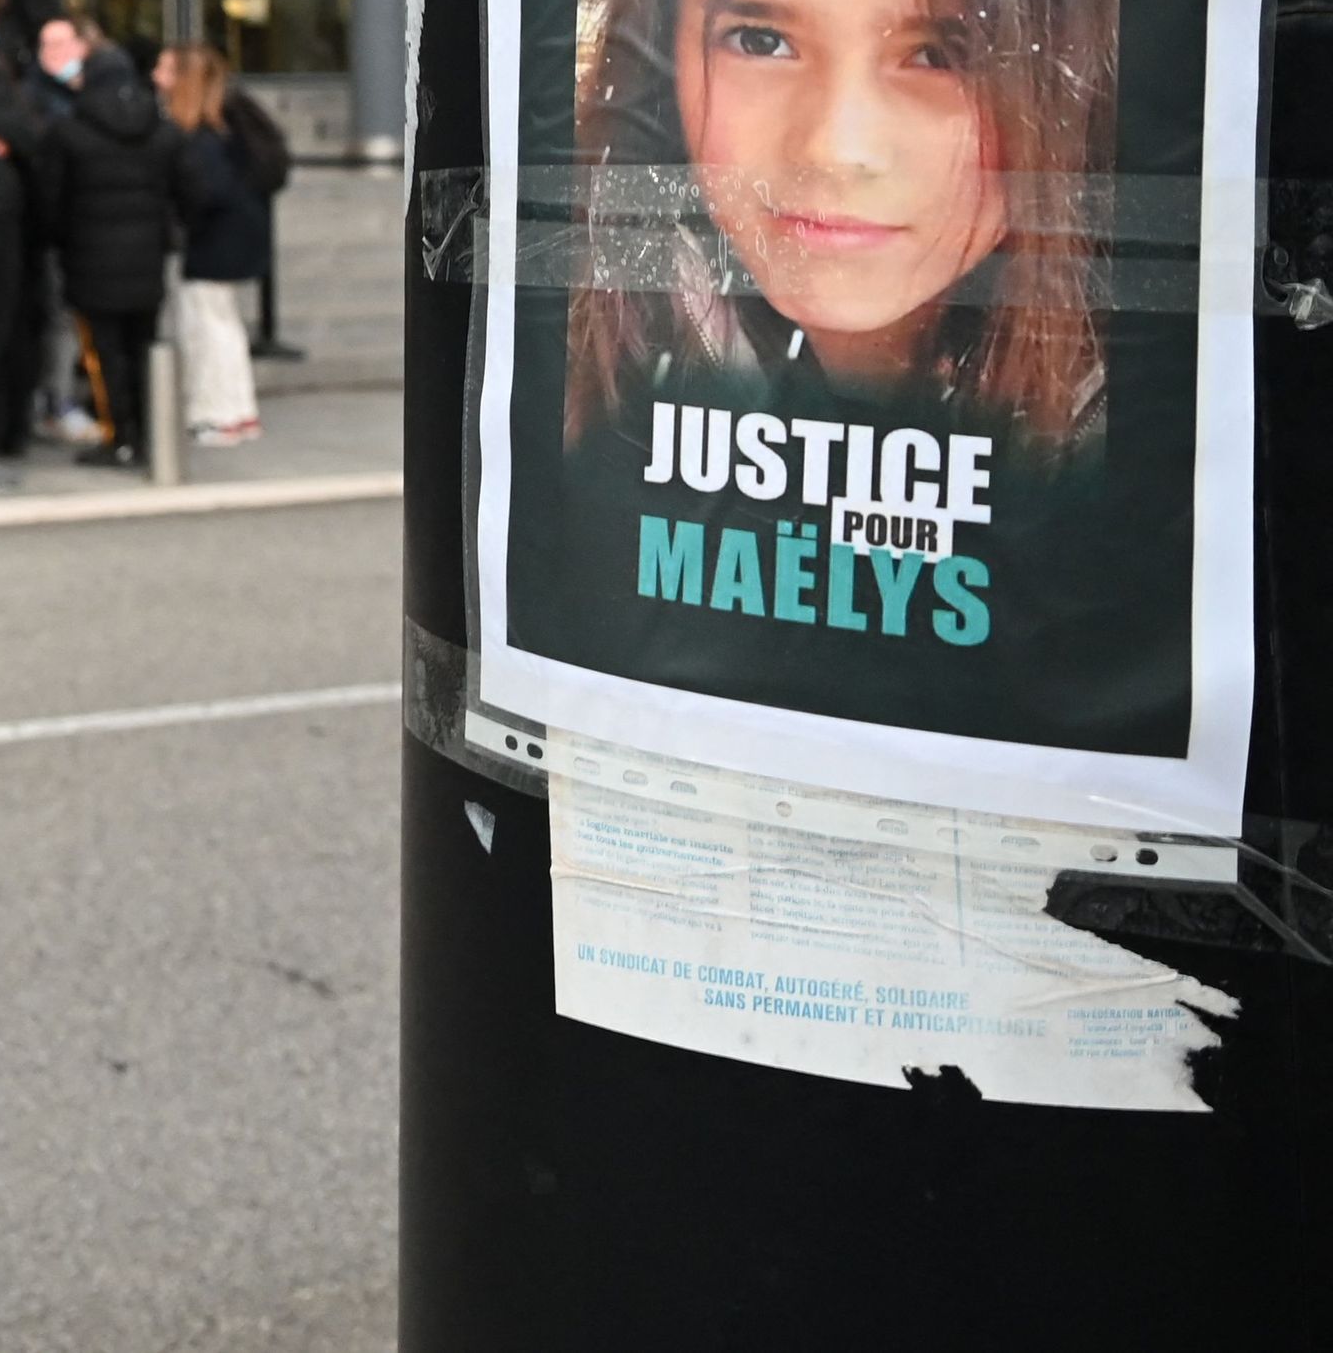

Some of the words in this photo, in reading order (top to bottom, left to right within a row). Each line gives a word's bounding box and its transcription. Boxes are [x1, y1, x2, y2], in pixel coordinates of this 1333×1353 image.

[643, 401, 993, 524] JUSTICE
[842, 509, 938, 552] POUR
[637, 514, 991, 647] MAËLYS
[577, 943, 595, 962] UN
[599, 947, 669, 976] SYNDICAT
[673, 960, 693, 980] DE
[697, 965, 769, 993] COMBAT,
[774, 975, 868, 1004] AUTOGÉRÉ,
[875, 985, 971, 1011] SOLIDAIRE
[704, 987, 746, 1011] SANS
[752, 994, 857, 1024] PERMANENT
[864, 1007, 886, 1027] ET
[891, 1011, 1048, 1038] ANTICAPITALISTE
